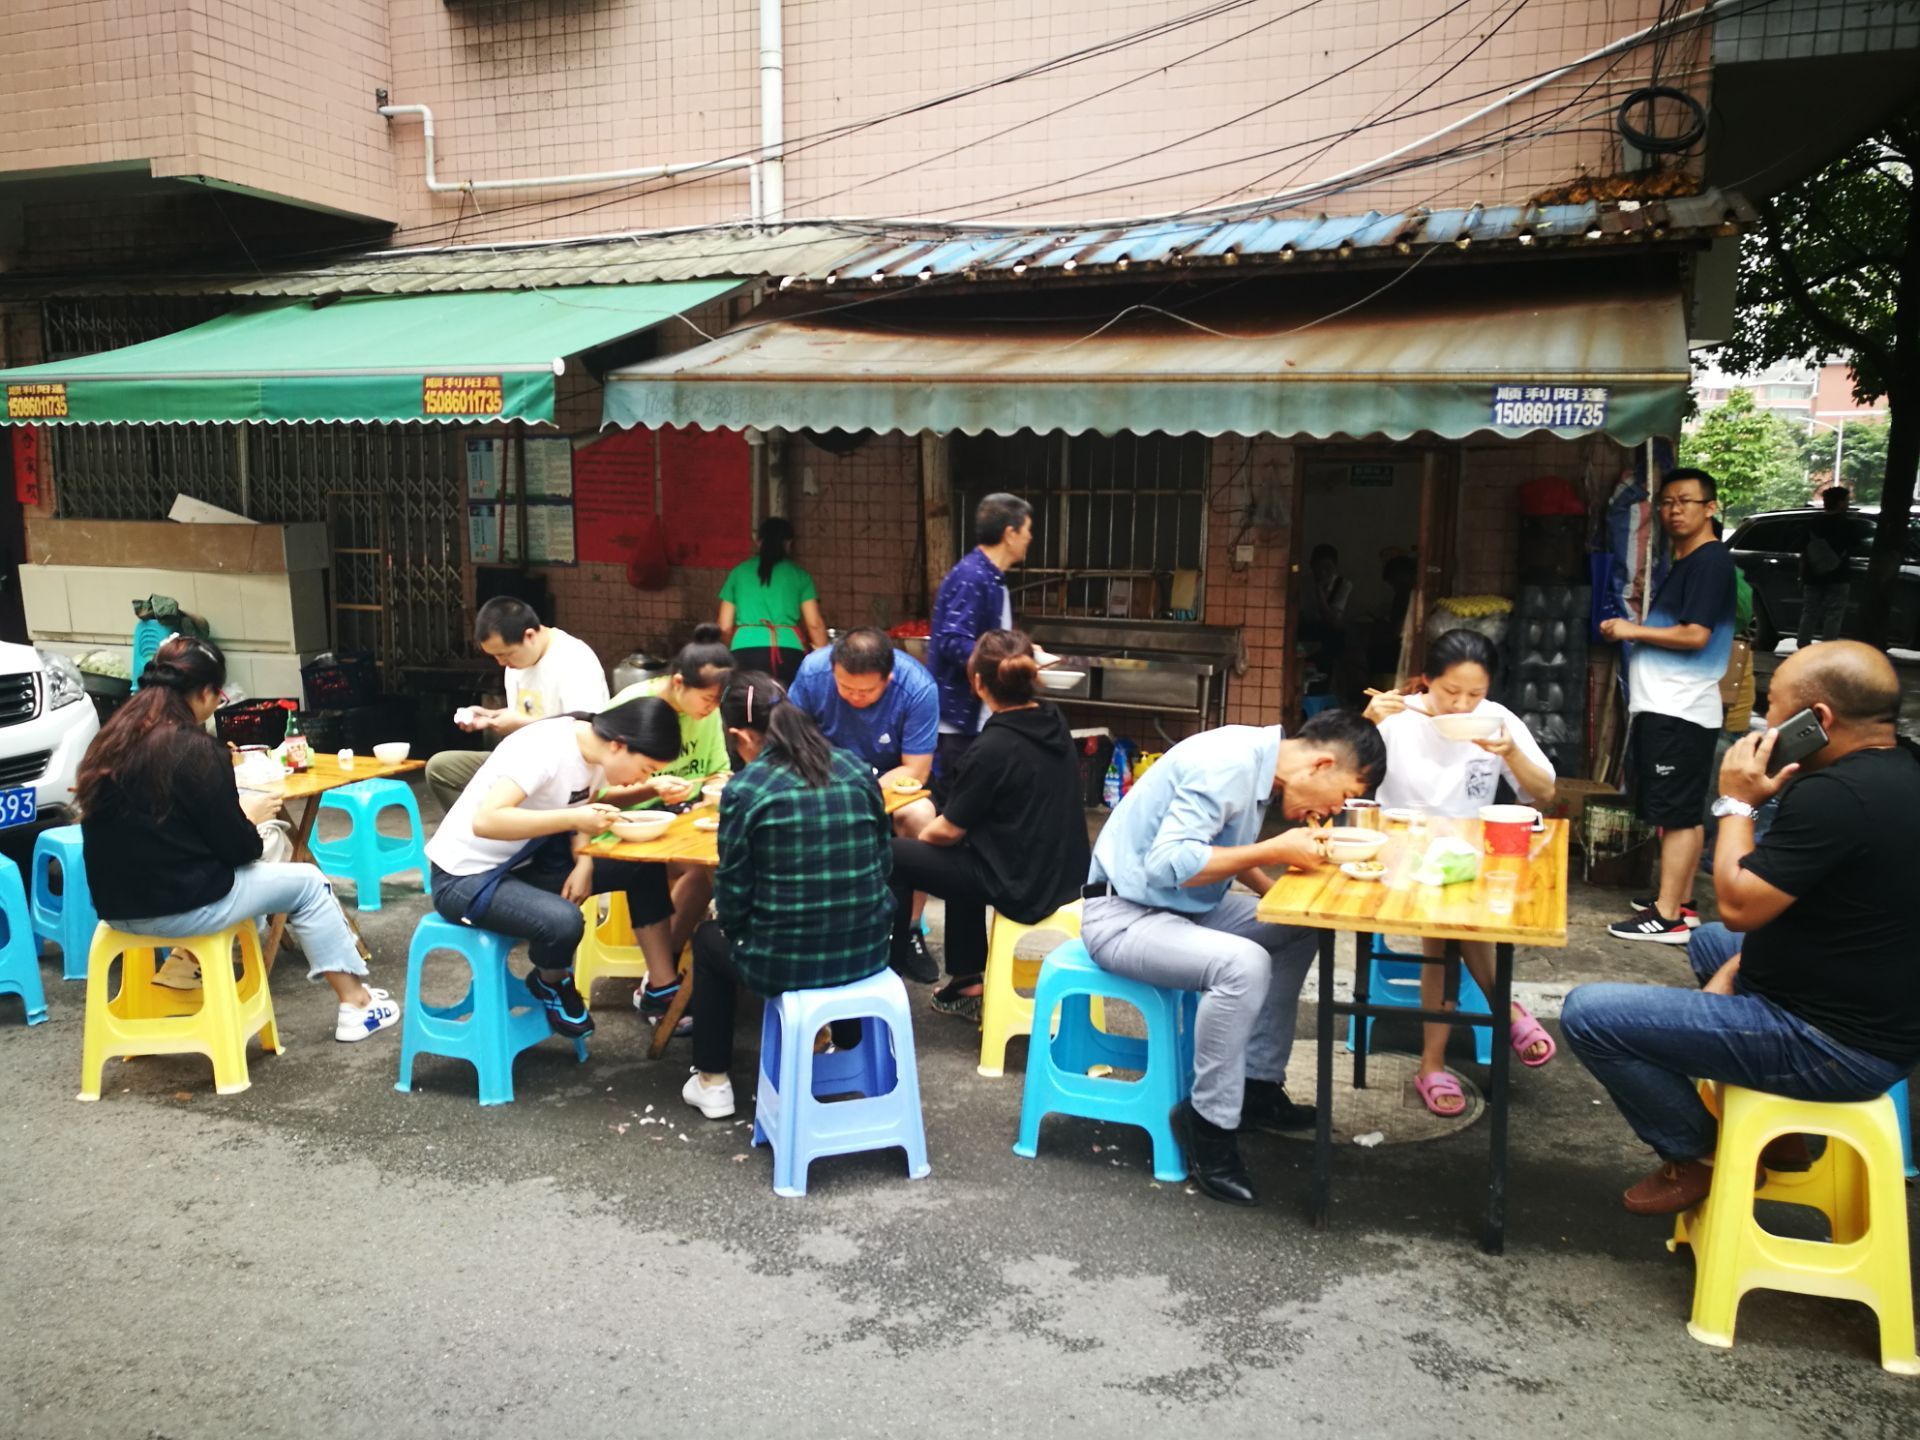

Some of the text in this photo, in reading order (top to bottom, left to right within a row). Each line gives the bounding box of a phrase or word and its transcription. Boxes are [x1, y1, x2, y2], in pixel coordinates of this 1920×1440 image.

[8, 395, 68, 417] 15086011735
[424, 390, 503, 414] 15086011735
[1494, 402, 1605, 426] 15086011735
